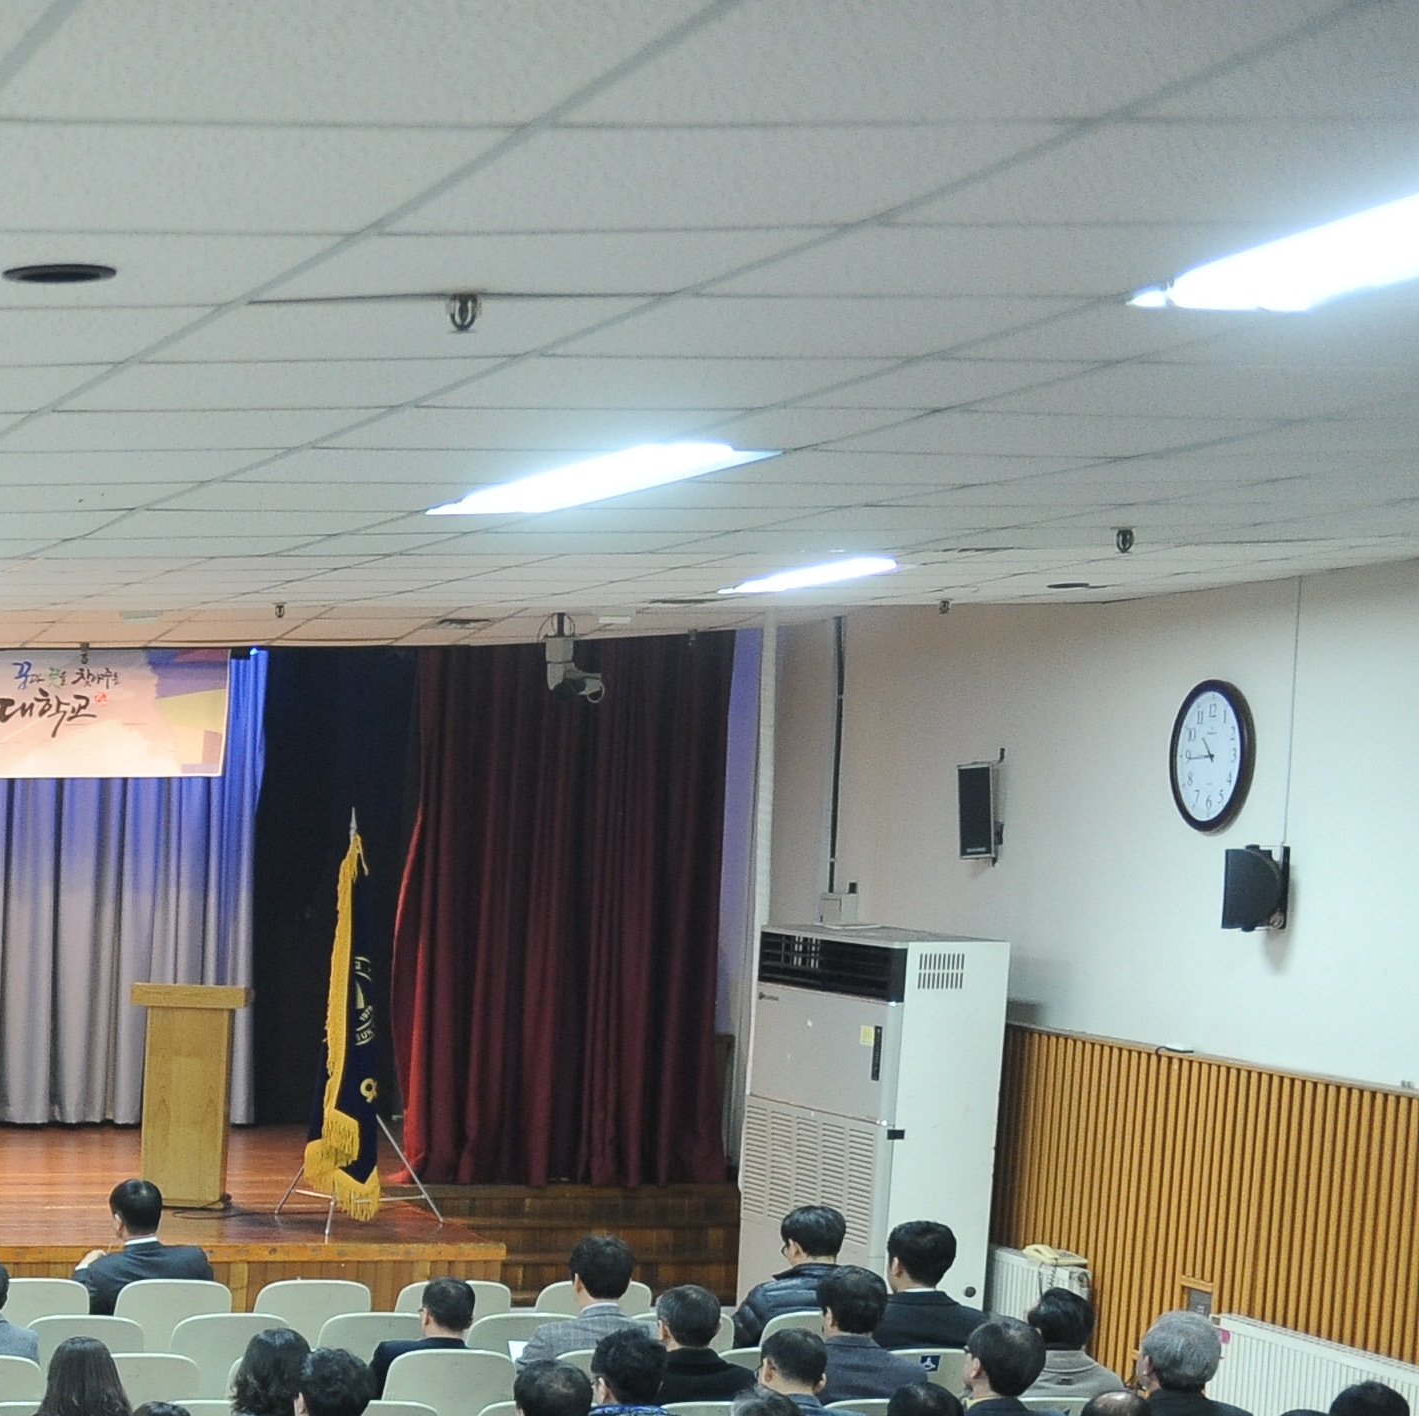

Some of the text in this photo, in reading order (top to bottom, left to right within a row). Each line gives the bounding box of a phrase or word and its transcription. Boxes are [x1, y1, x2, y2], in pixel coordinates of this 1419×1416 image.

[1197, 710, 1203, 725] 11
[1208, 703, 1217, 718] 12
[1223, 709, 1227, 724] 1
[1187, 727, 1196, 742] 10
[1230, 726, 1236, 741] 2
[1185, 749, 1192, 764] 9
[1231, 748, 1237, 763] 3
[1187, 771, 1193, 787] 8
[1226, 771, 1232, 785] 4
[1194, 789, 1200, 804] 7
[1205, 794, 1212, 810] 6
[1218, 788, 1224, 804] 5
